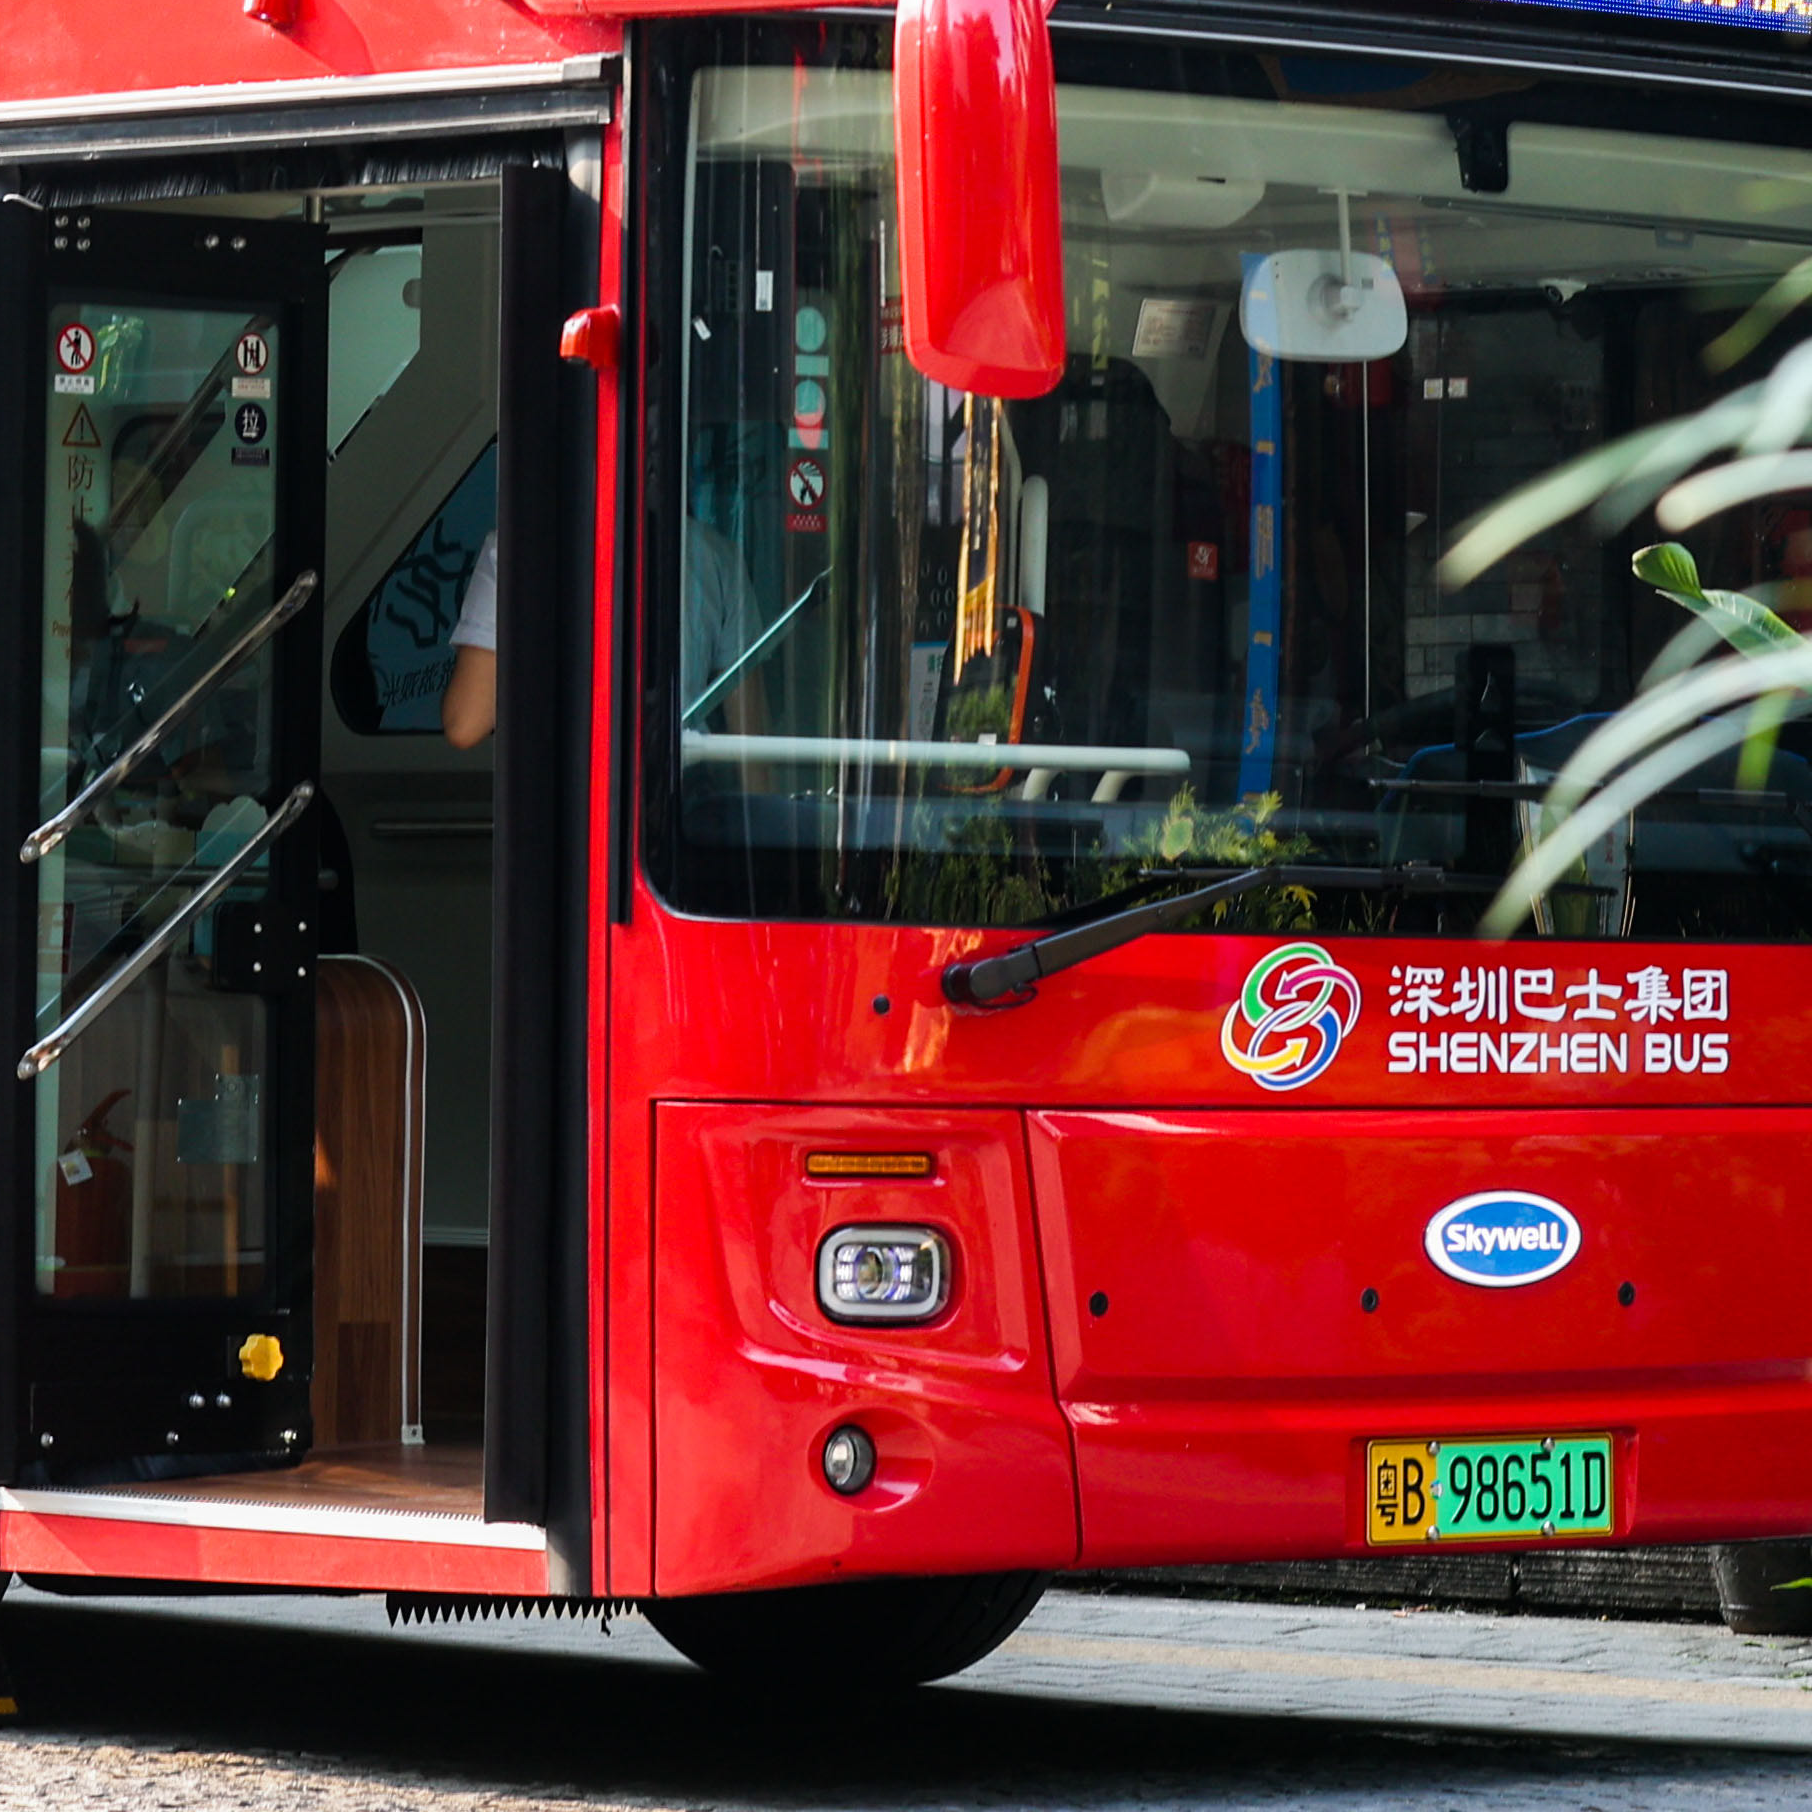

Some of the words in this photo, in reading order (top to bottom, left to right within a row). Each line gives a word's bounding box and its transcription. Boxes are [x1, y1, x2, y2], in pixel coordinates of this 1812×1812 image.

[1388, 964, 1729, 1025] 深圳巴士集团
[1388, 1032, 1628, 1075] SHENZHEN
[1642, 1032, 1729, 1074] BUS
[1445, 1220, 1563, 1256] Skywell
[1375, 1456, 1426, 1527] 粤B
[1448, 1448, 1608, 1526] 98651D
